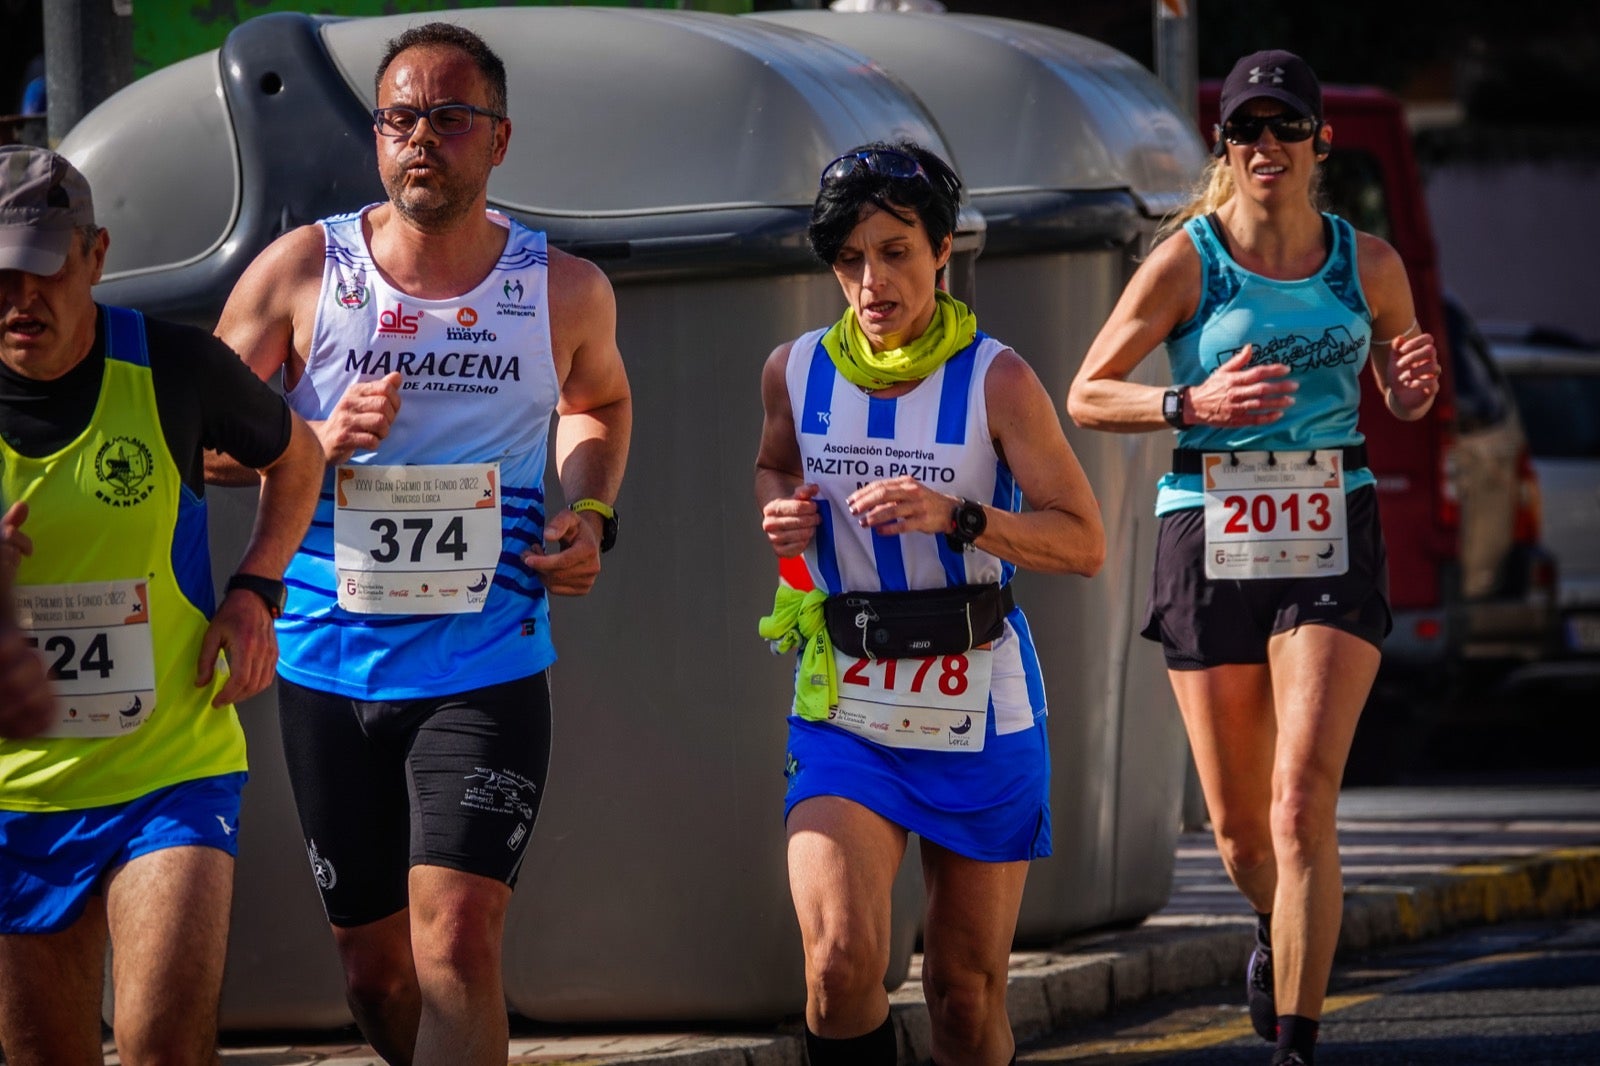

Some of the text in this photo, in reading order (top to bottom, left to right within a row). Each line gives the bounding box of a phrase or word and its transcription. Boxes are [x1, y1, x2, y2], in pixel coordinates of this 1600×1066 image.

[503, 309, 536, 318] Maracena
[446, 329, 497, 344] mayfo
[345, 349, 521, 382] MARACENA
[403, 381, 499, 395] DE ATLETISMO
[823, 443, 935, 461] Asociación Deportiva
[806, 457, 956, 483] PAZITO a PAZITO
[95, 484, 154, 508] GRANADA
[459, 478, 479, 490] 2022
[1223, 492, 1332, 534] 2013
[369, 515, 468, 563] 374
[25, 633, 114, 680] 24
[842, 653, 969, 696] 2178
